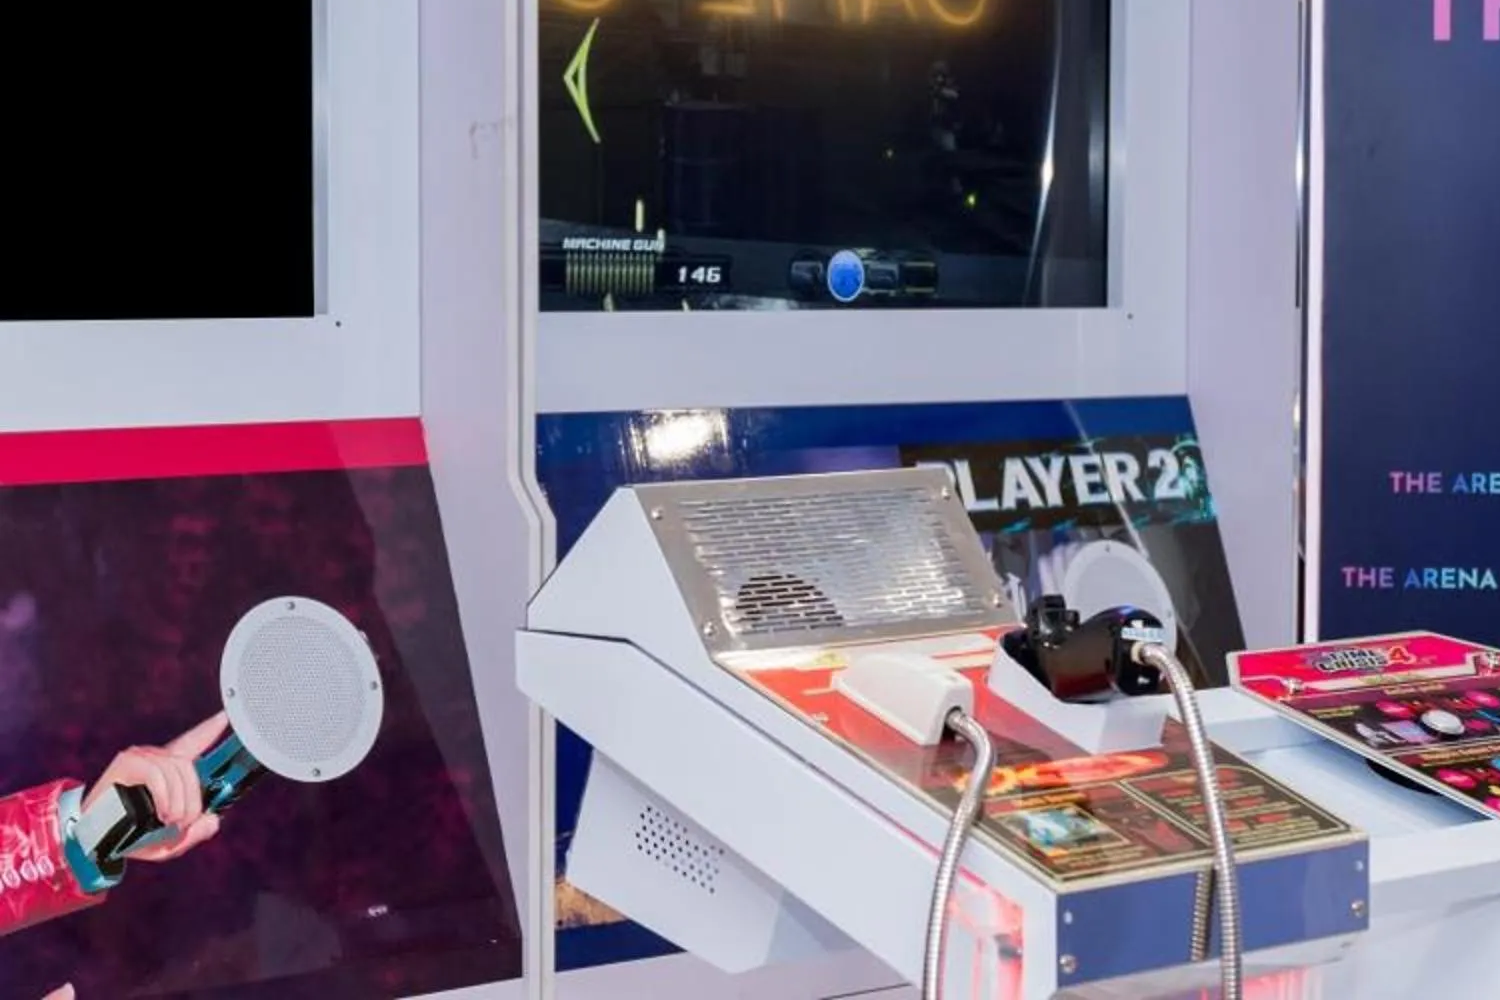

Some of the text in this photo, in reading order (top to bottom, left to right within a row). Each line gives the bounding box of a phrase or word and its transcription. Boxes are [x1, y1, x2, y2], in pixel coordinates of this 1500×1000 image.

[563, 238, 631, 251] MACHINE
[678, 265, 722, 284] 146
[1148, 448, 1187, 500] 2
[1390, 471, 1443, 494] THE
[1341, 566, 1498, 590] THE ARENA
